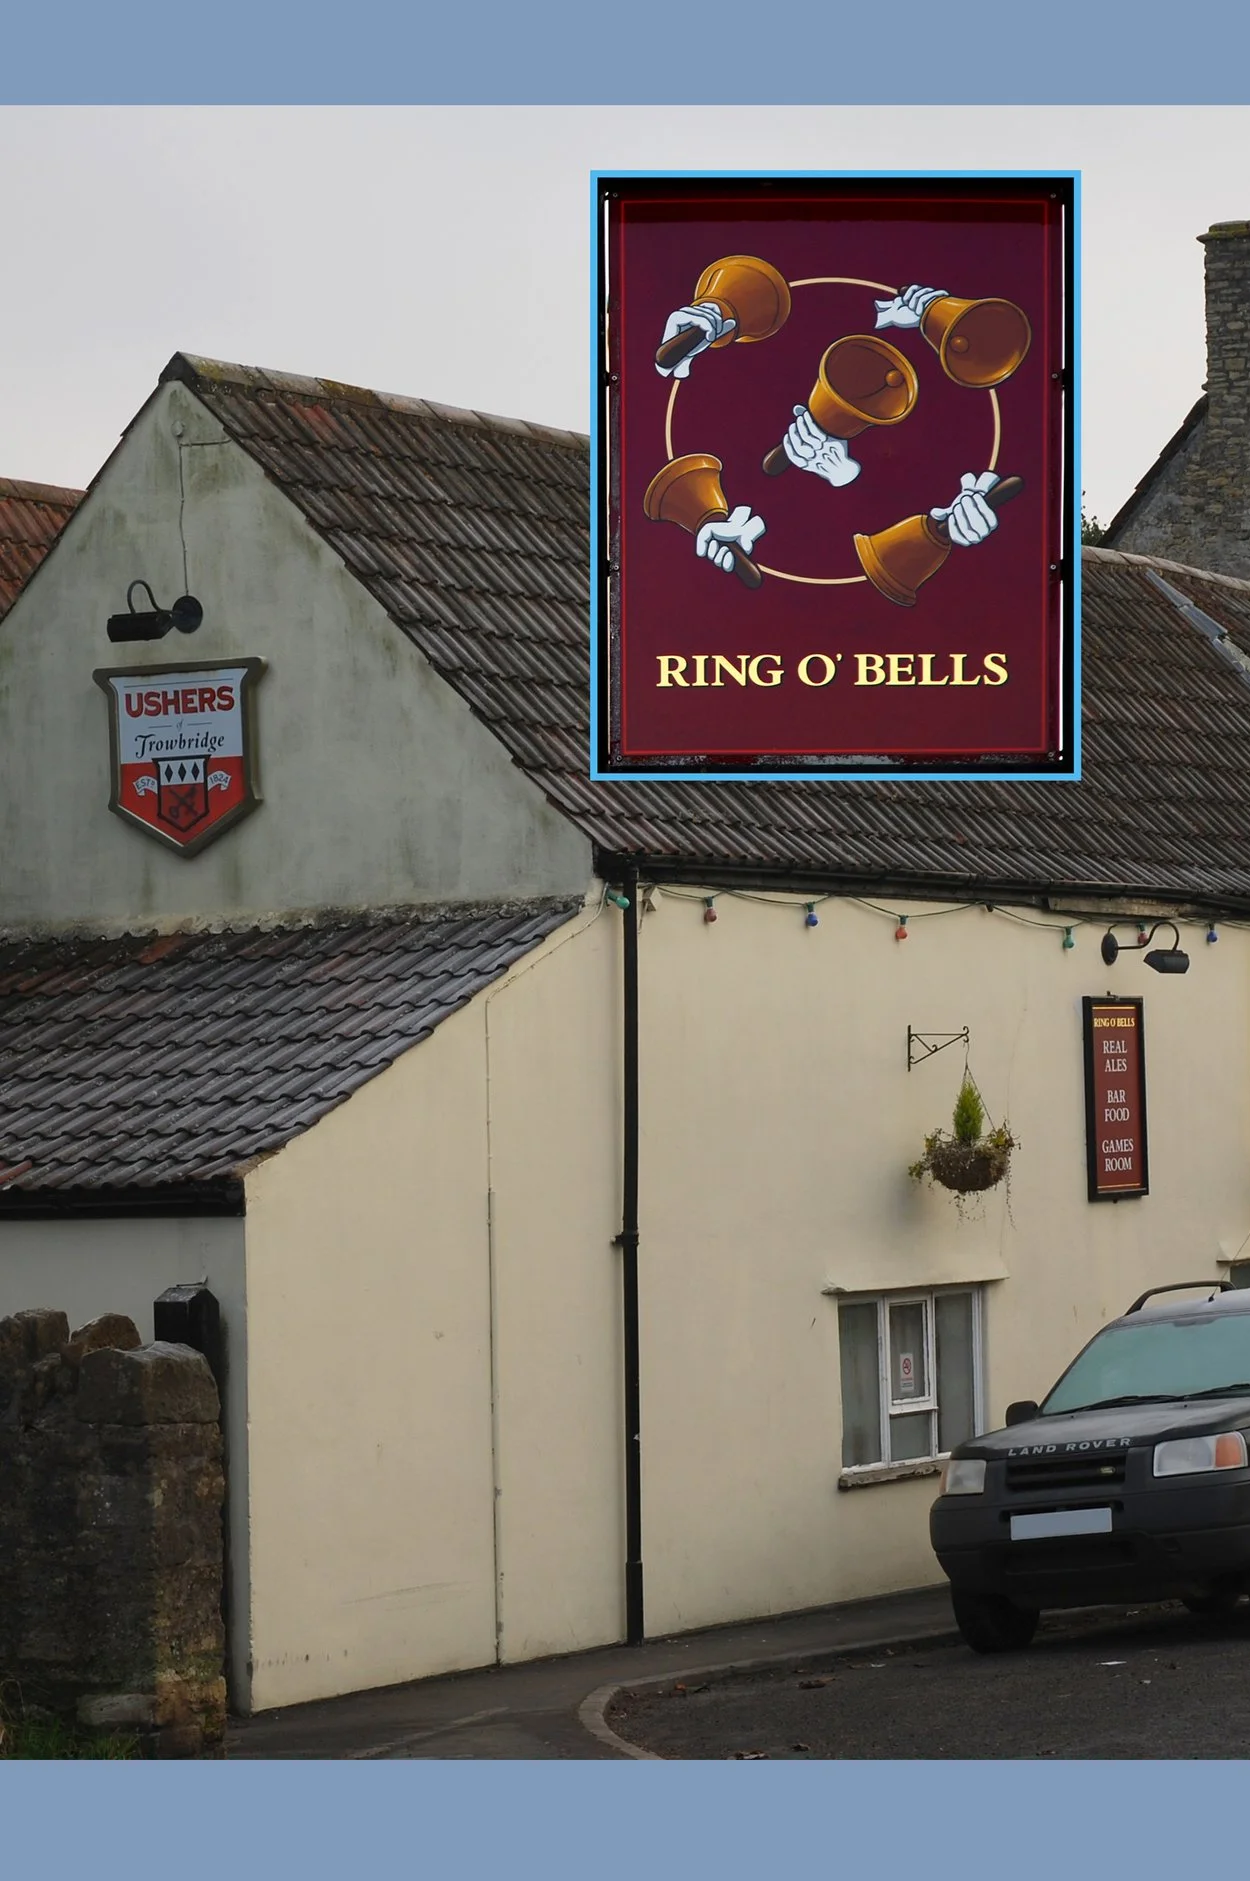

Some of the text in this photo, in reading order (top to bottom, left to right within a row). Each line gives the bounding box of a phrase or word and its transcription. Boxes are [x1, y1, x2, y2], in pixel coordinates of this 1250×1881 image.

[656, 653, 1009, 688] RING O' BELLS
[125, 686, 235, 718] USHERS
[134, 731, 225, 759] Trowbridge
[209, 773, 229, 785] 1824
[1093, 1018, 1109, 1028] RING
[1117, 1017, 1135, 1027] BELLS
[1103, 1040, 1128, 1054] REAL
[1104, 1058, 1128, 1073] ALES
[1107, 1089, 1126, 1104] BAR
[1104, 1107, 1130, 1122] FOOD
[1101, 1138, 1134, 1154] GAMES
[1104, 1157, 1132, 1172] ROOM
[1007, 1437, 1131, 1457] LAND ROVER
